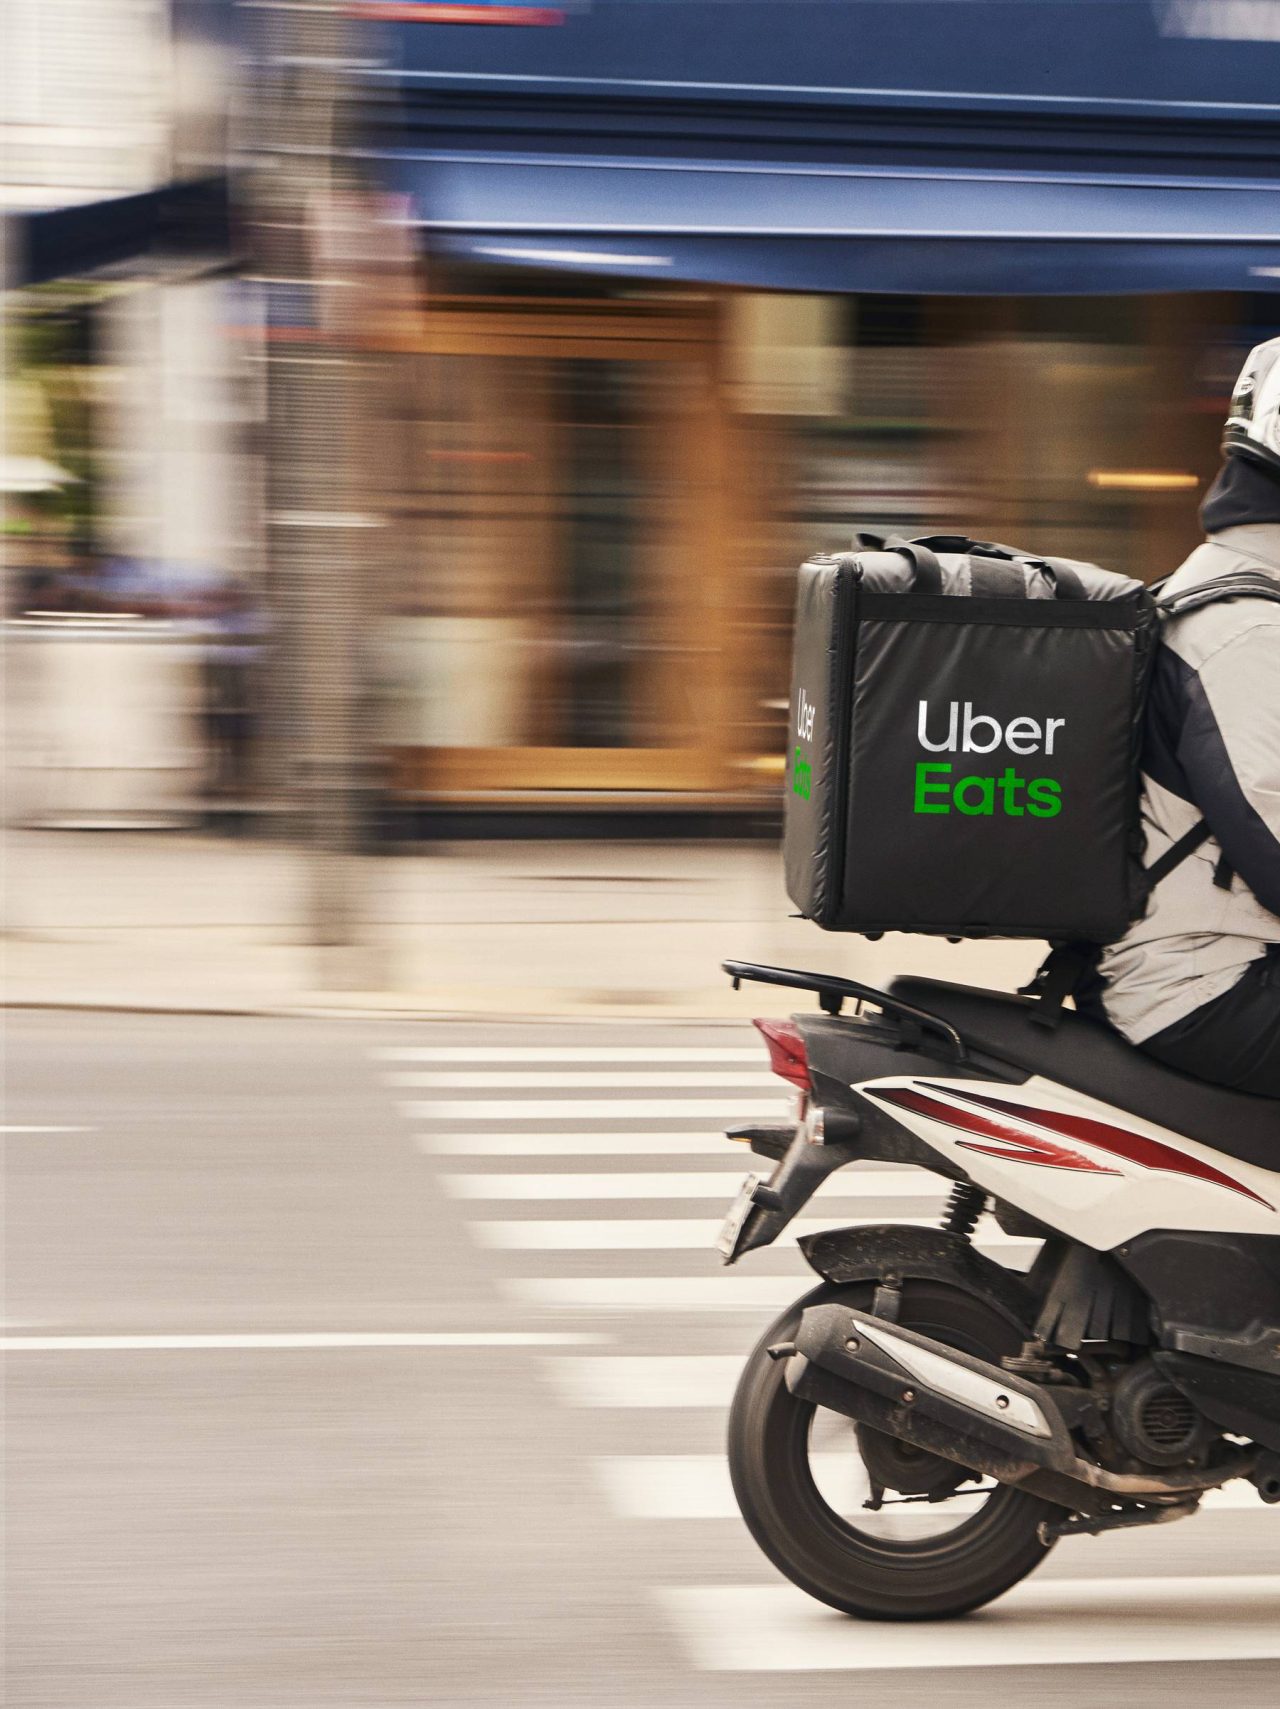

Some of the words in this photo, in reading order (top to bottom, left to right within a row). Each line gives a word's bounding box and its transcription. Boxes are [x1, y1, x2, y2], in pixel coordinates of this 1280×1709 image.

[797, 688, 815, 742] Uber
[917, 700, 1065, 755] Uber
[914, 762, 1062, 818] Eats
